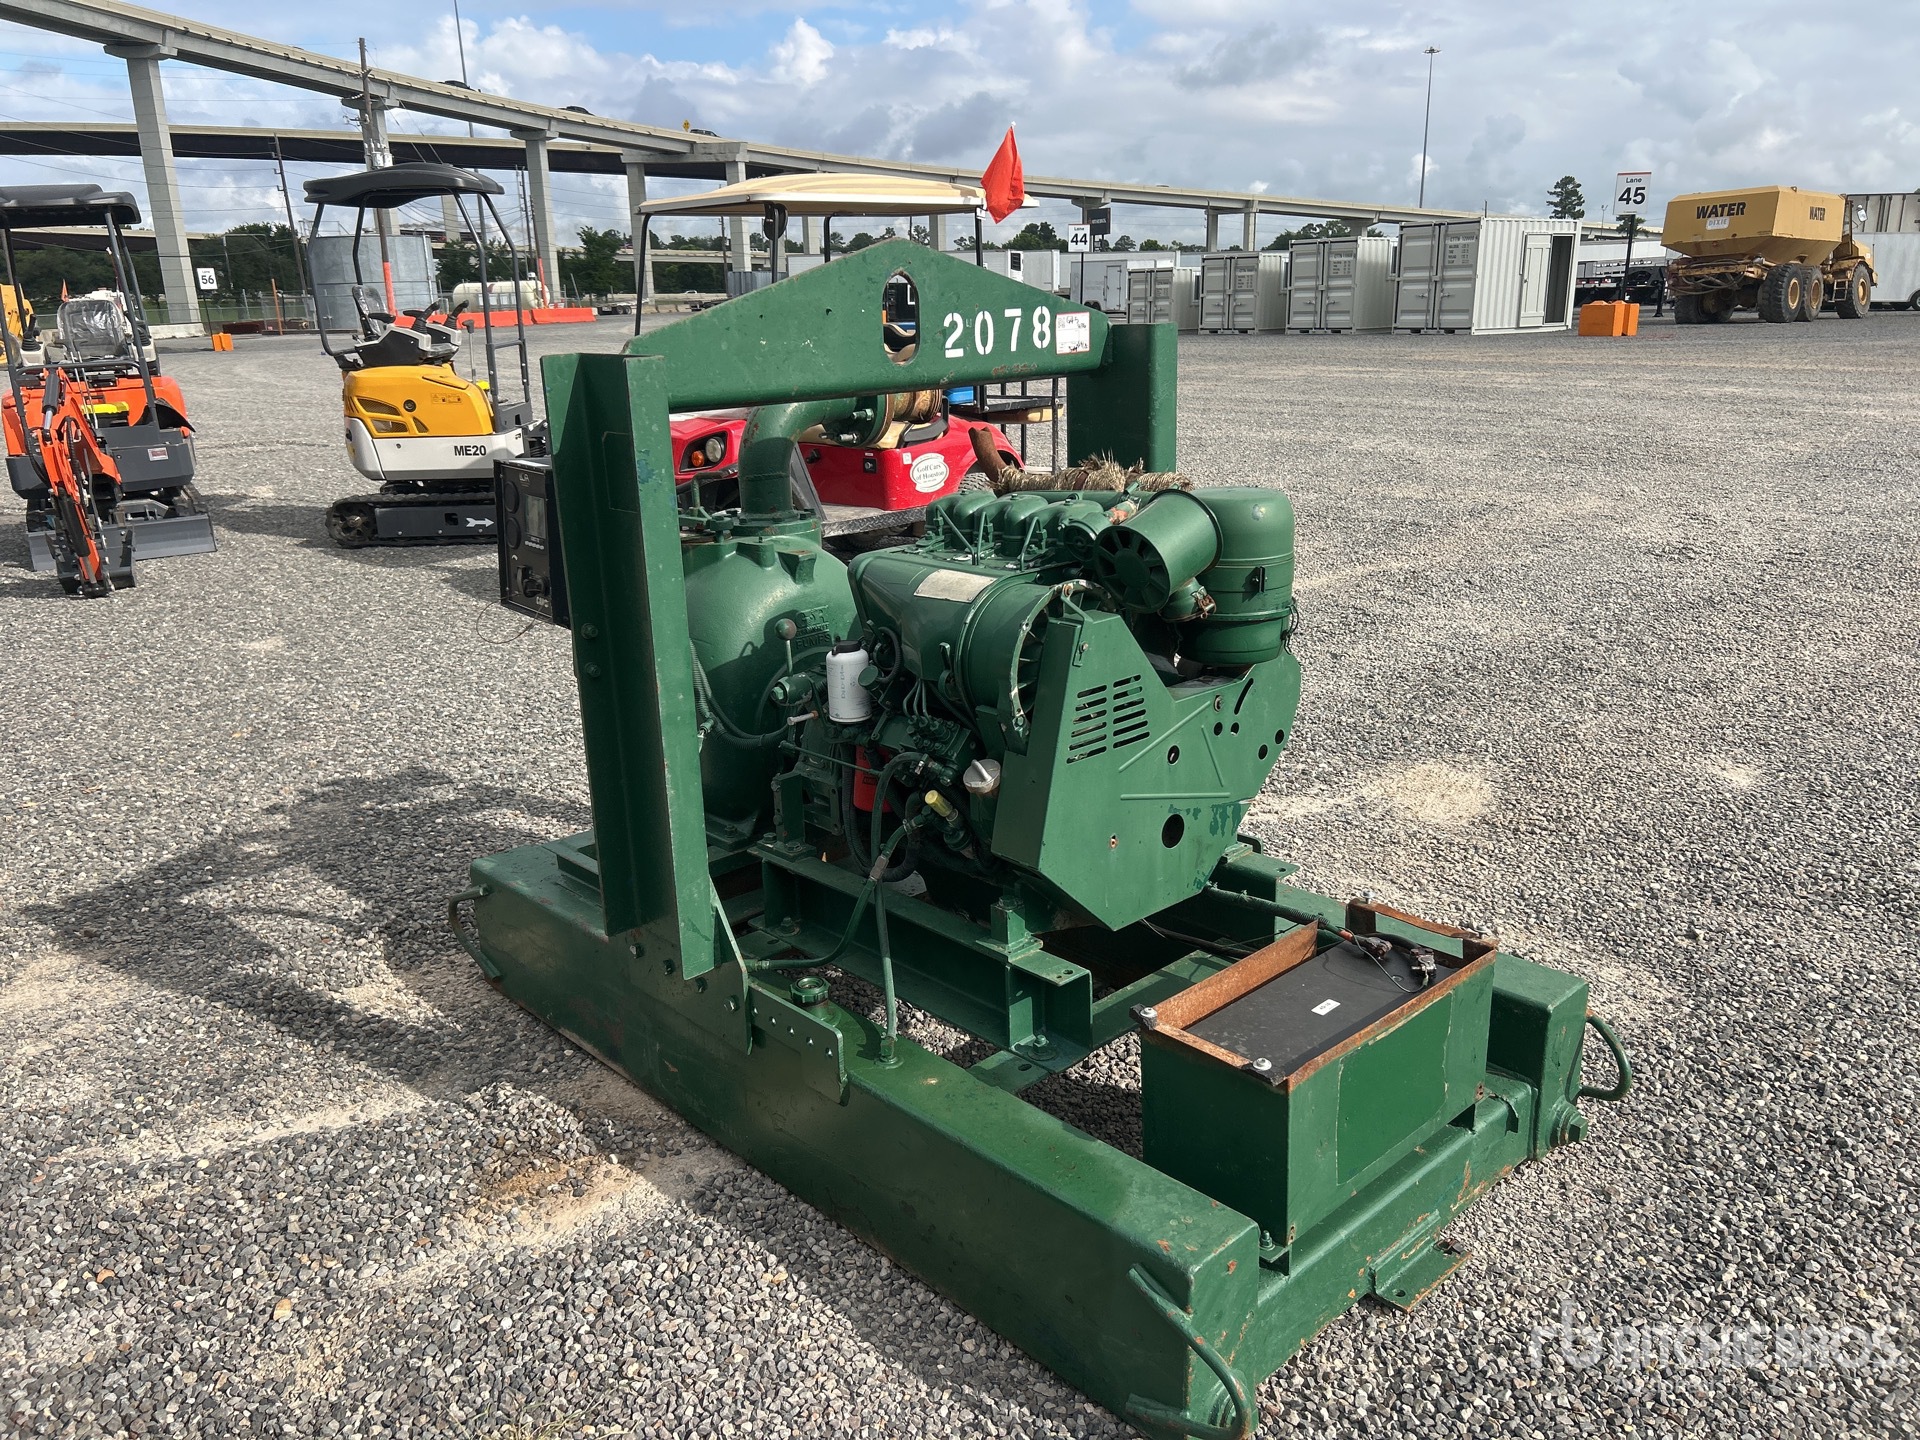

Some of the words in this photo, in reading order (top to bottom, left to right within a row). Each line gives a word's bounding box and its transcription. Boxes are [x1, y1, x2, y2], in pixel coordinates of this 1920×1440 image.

[1618, 187, 1646, 205] 45
[1696, 202, 1747, 220] WATER
[1809, 206, 1826, 222] WATER
[1708, 218, 1728, 227] DIXIE
[1070, 233, 1088, 245] 44
[201, 275, 215, 284] 56
[942, 305, 1051, 359] 2078
[454, 445, 487, 456] ME20
[917, 464, 929, 473] Golf
[929, 463, 942, 471] Cars
[922, 471, 945, 479] Houston
